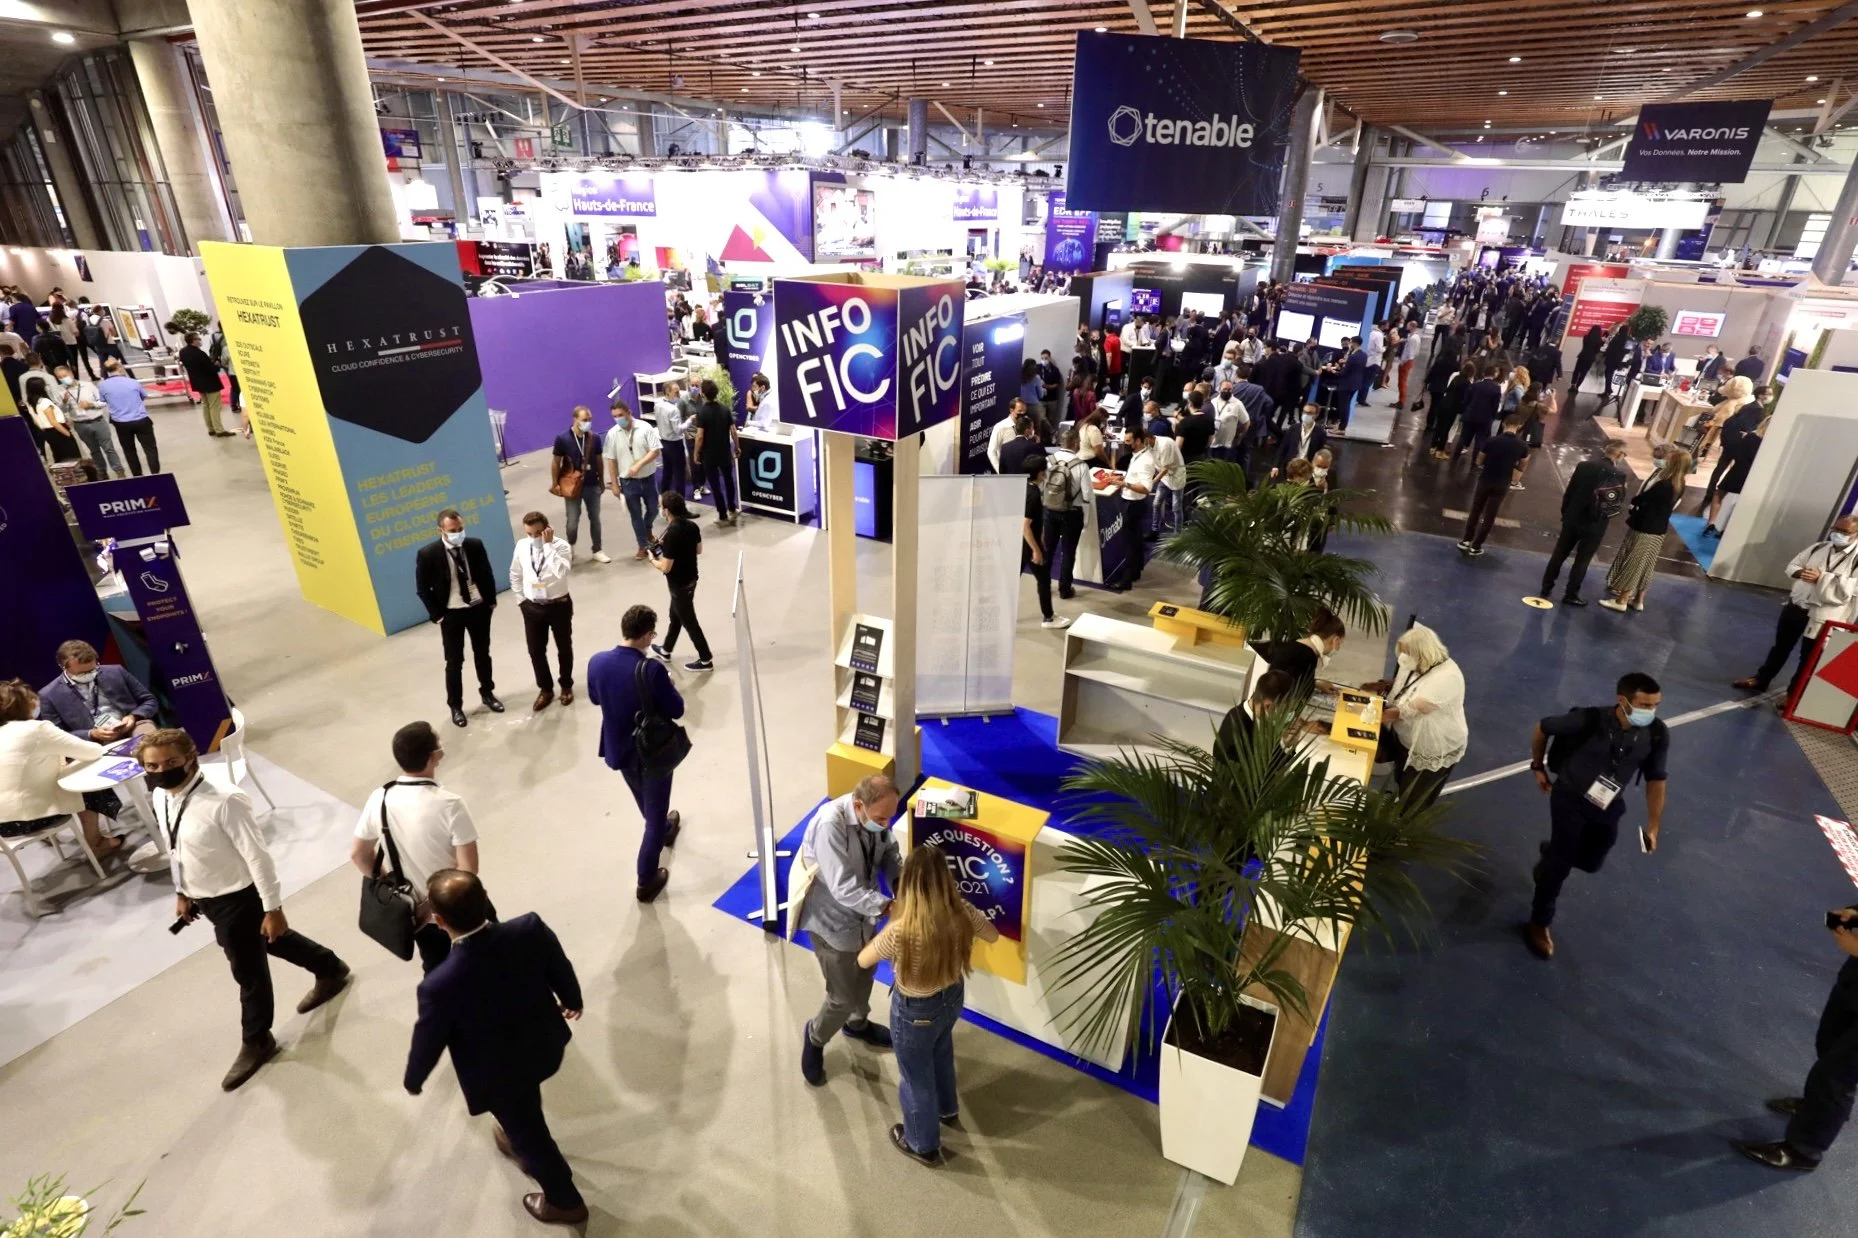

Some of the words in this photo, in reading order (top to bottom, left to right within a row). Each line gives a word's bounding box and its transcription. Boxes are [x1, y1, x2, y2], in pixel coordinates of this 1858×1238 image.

[1145, 112, 1254, 148] tenable
[1664, 128, 1750, 140] VARONIS
[573, 198, 655, 212] Hauts-de-France
[1568, 208, 1628, 218] THALES
[237, 310, 280, 328] HEXATRUST
[781, 297, 872, 357] INFO
[903, 294, 952, 367] INFO
[327, 326, 460, 354] HEXATRUST
[972, 342, 984, 354] VOIR
[332, 362, 358, 372] CLOUD
[359, 356, 404, 368] CONFIDENCE
[411, 346, 464, 360] CYBERSECURITY
[729, 353, 760, 362] OPENCYBER
[972, 356, 984, 368] TOUT
[796, 343, 890, 418] FIC
[910, 335, 960, 423] FIC
[971, 370, 992, 386] PRÉDIRE
[970, 388, 978, 400] CE
[978, 386, 986, 398] QUI
[986, 383, 995, 396] EST
[970, 396, 996, 414] IMPORTANT
[970, 419, 982, 431] AGIR
[969, 431, 982, 444] POUR
[358, 462, 436, 492] HEXATRUST
[363, 493, 388, 508] LES
[392, 474, 452, 499] LEADERS
[752, 491, 784, 502] OPENCYBER
[366, 492, 448, 524] EUROPÉENS
[370, 526, 390, 540] DU
[460, 498, 477, 512] DE
[480, 494, 494, 506] LA
[148, 596, 178, 607] PROTECT
[156, 604, 175, 612] YOUR
